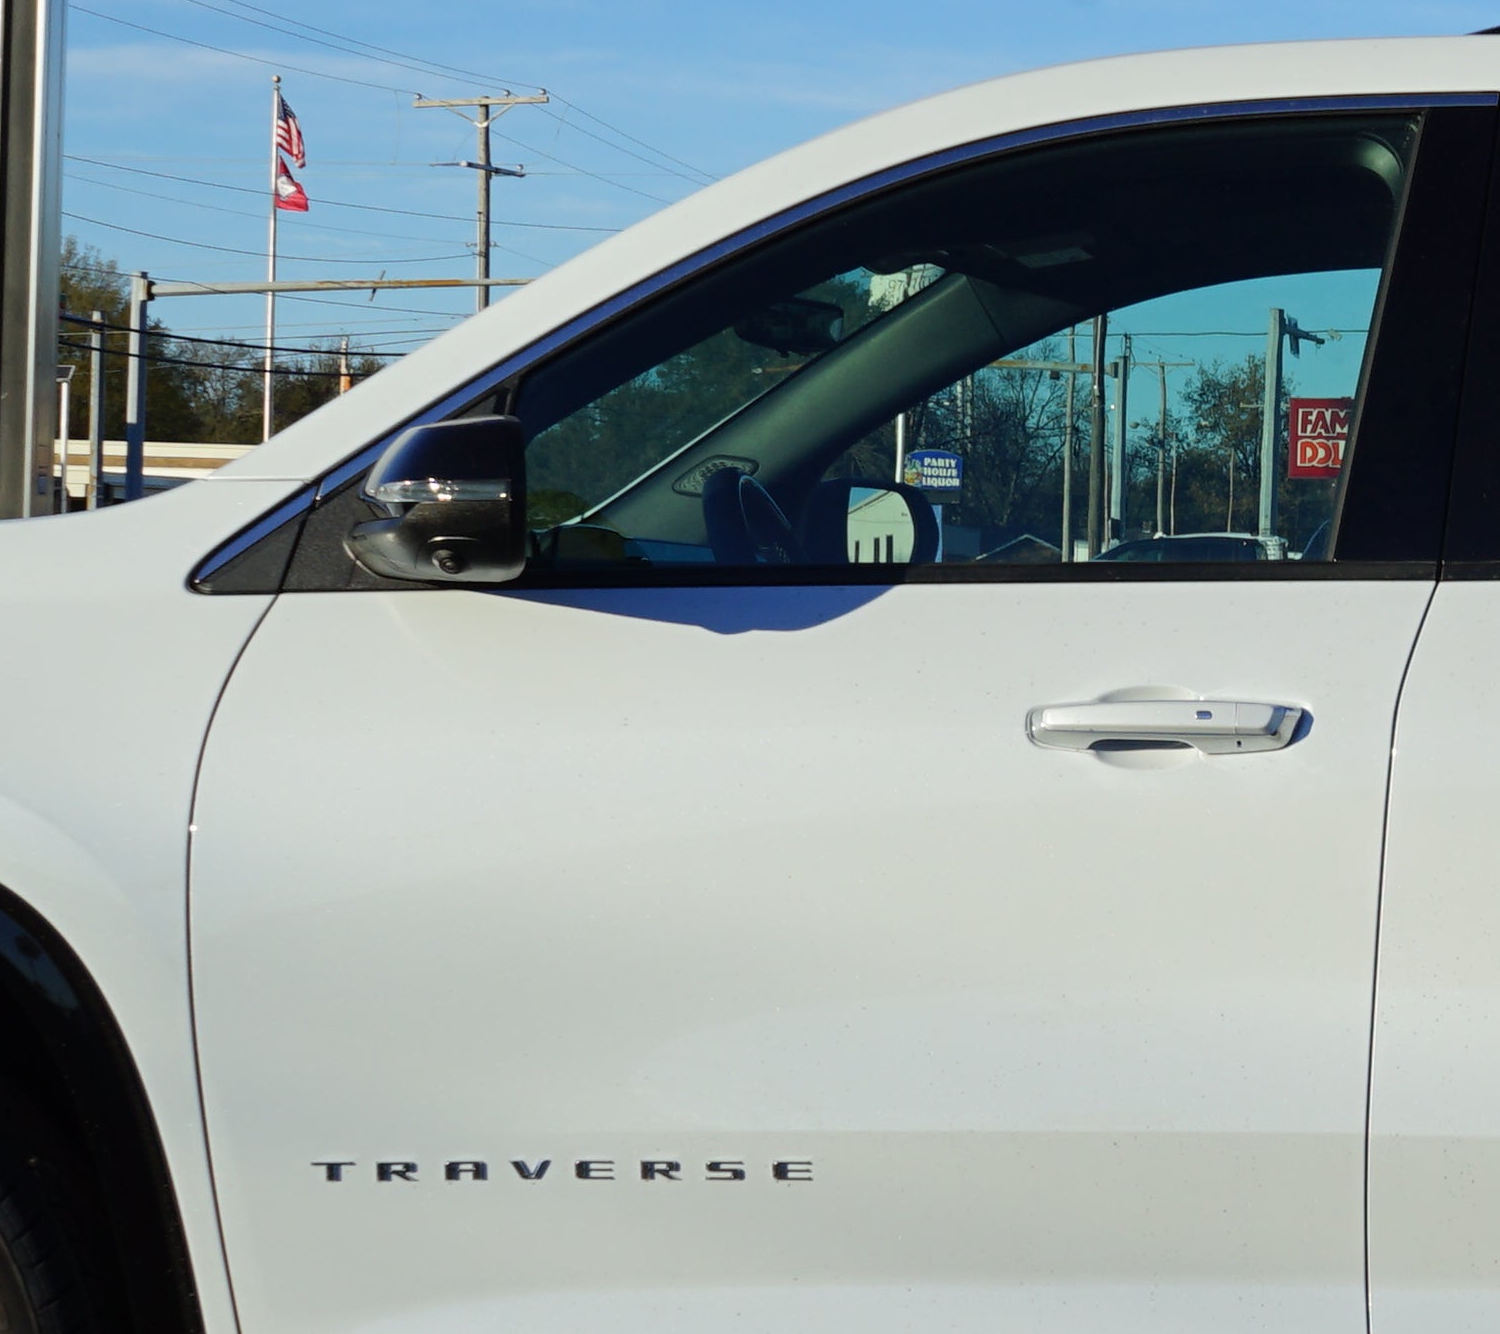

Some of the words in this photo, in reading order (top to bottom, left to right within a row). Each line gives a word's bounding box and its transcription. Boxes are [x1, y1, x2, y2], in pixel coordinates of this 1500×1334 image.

[923, 457, 957, 468] PARTY
[923, 467, 958, 477] HOUSE
[922, 476, 960, 487] LIQUOR
[310, 1159, 814, 1183] TRAVERSE
